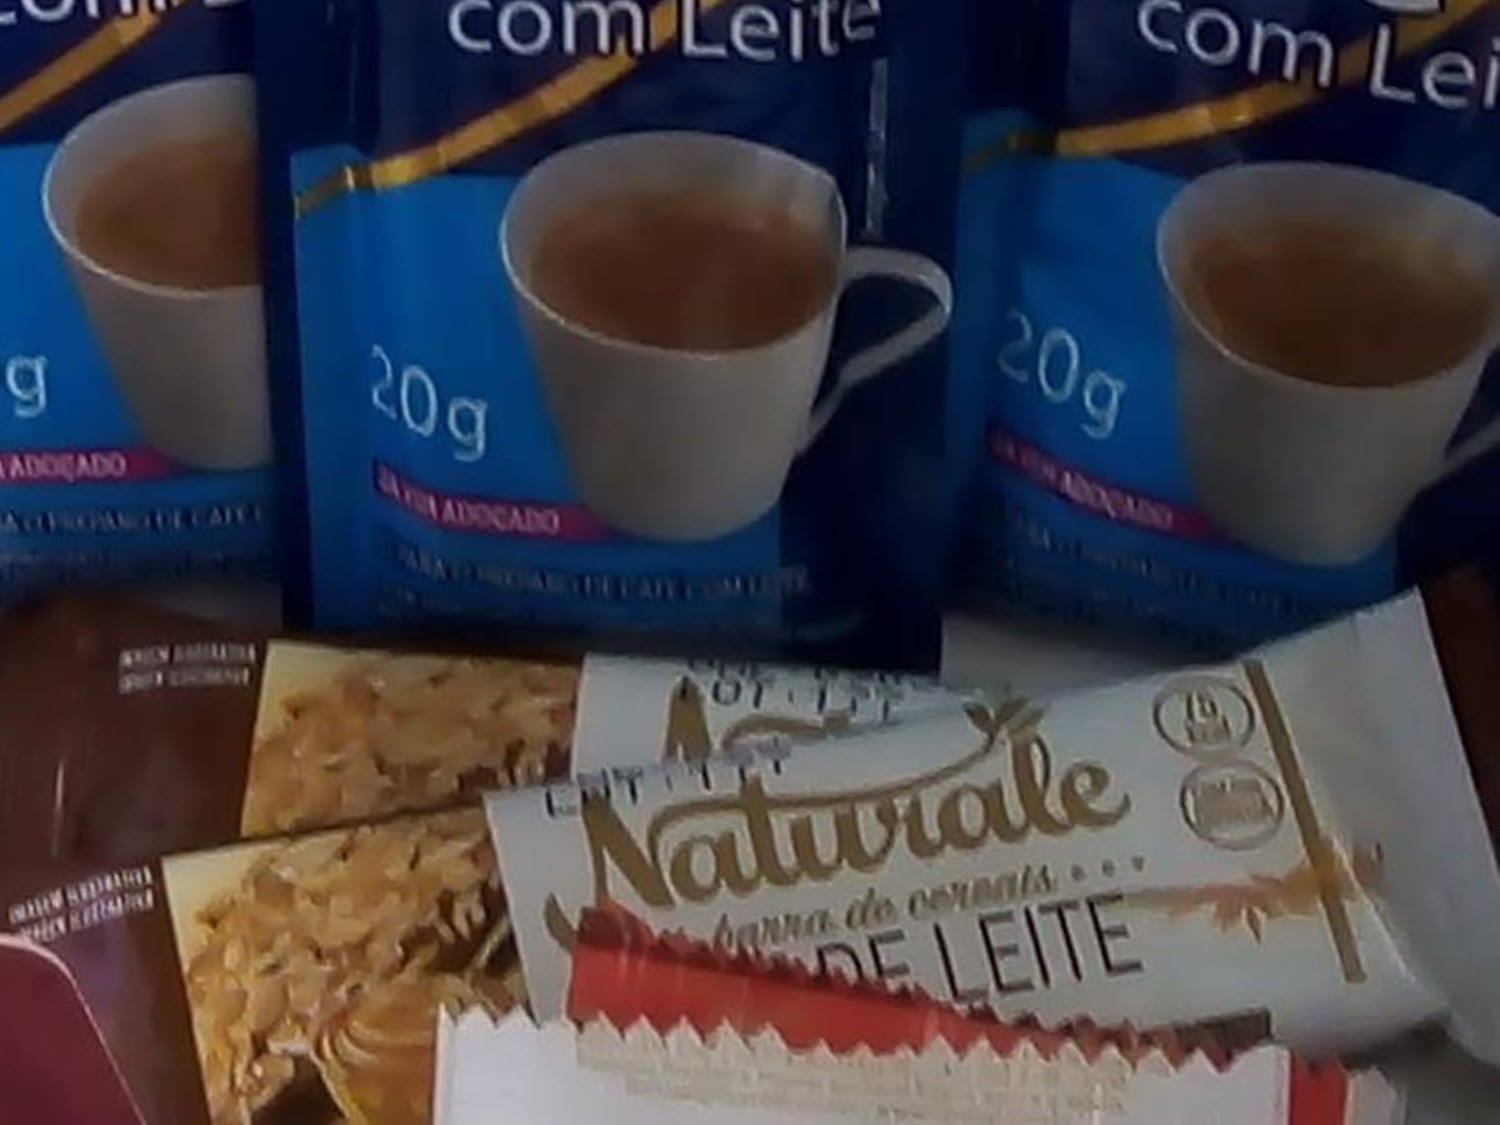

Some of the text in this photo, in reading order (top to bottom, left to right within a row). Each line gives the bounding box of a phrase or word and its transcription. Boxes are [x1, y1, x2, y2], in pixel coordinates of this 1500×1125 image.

[370, 343, 490, 463] 20g
[998, 309, 1128, 441] 20g
[575, 710, 1132, 912] Naturale
[814, 892, 1144, 1003] DE LEITE
